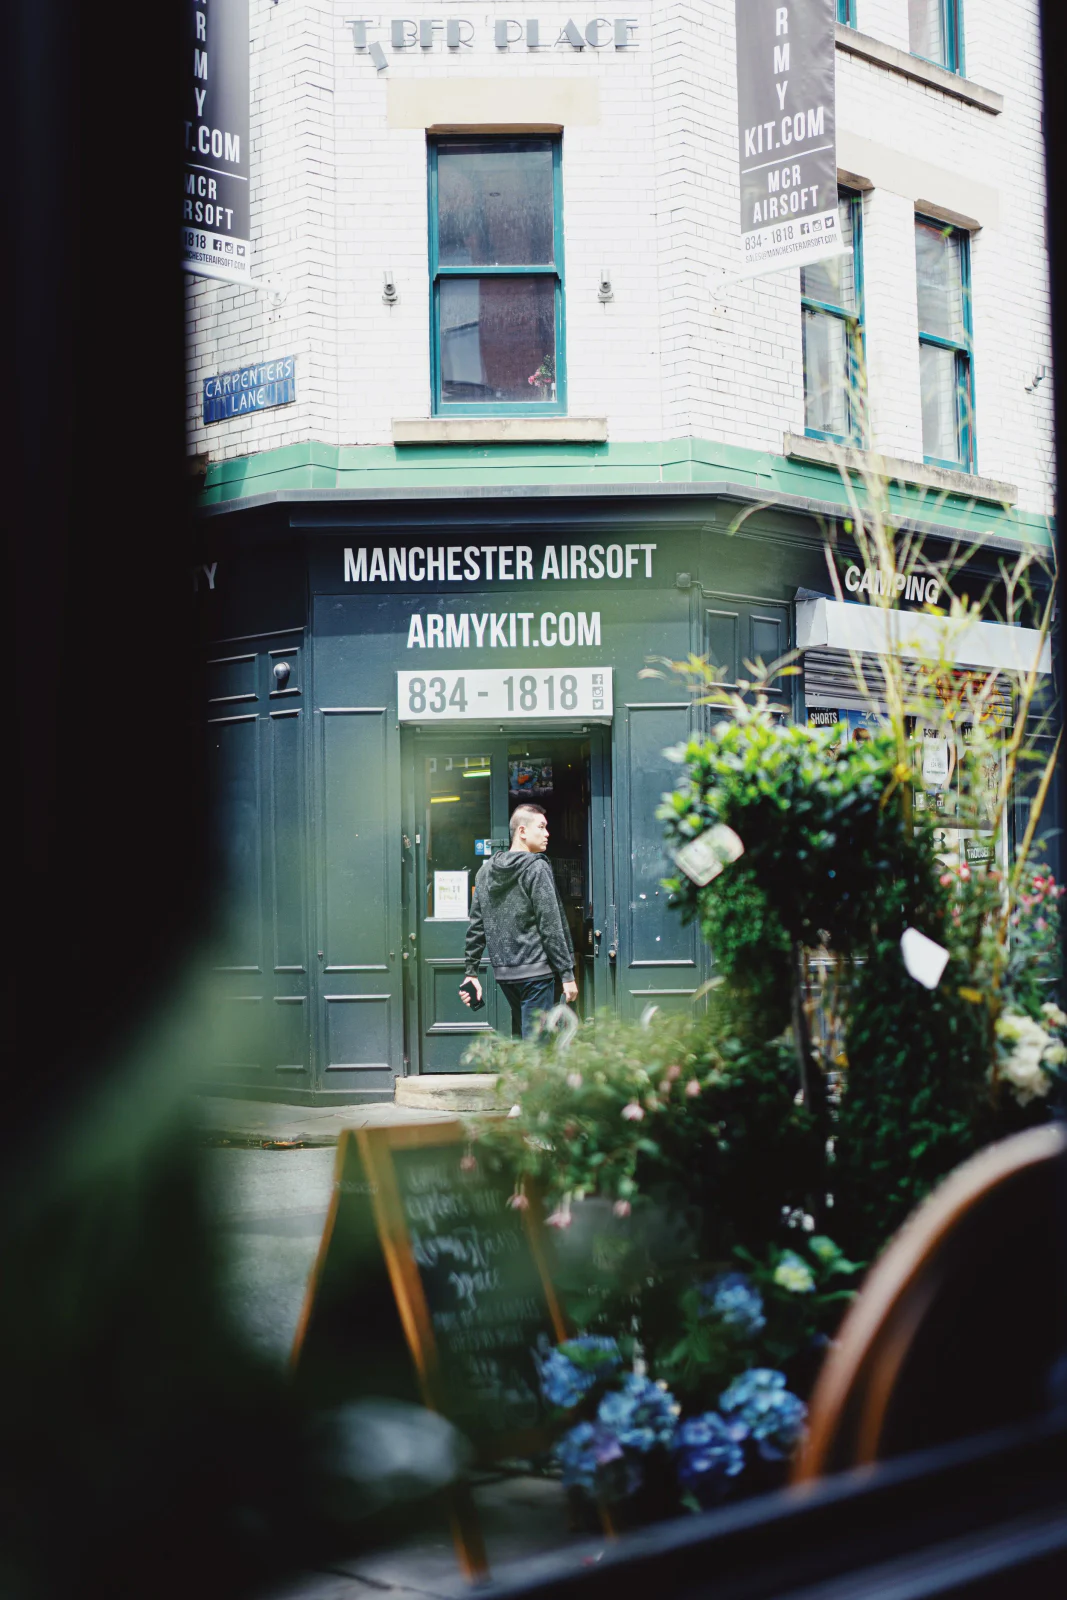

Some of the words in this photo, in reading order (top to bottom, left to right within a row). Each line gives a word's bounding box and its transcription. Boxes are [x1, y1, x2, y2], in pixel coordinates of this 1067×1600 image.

[495, 18, 640, 48] PLACE
[193, 0, 208, 117] RMY
[744, 107, 825, 157] KIT.COM
[768, 164, 801, 193] MCR
[753, 185, 819, 224] AIRSOFT
[745, 234, 762, 251] 834
[772, 225, 794, 244] 1818
[205, 359, 292, 398] CARPENTERS
[232, 388, 265, 412] LANE
[344, 545, 534, 582] MANCHESTER
[541, 543, 657, 580] AIRSOFT
[844, 565, 940, 604] CAMPING
[407, 611, 602, 649] ARMYKIT.COM
[408, 676, 468, 713] 834
[502, 673, 578, 711] 1818
[810, 712, 838, 725] SHORTS
